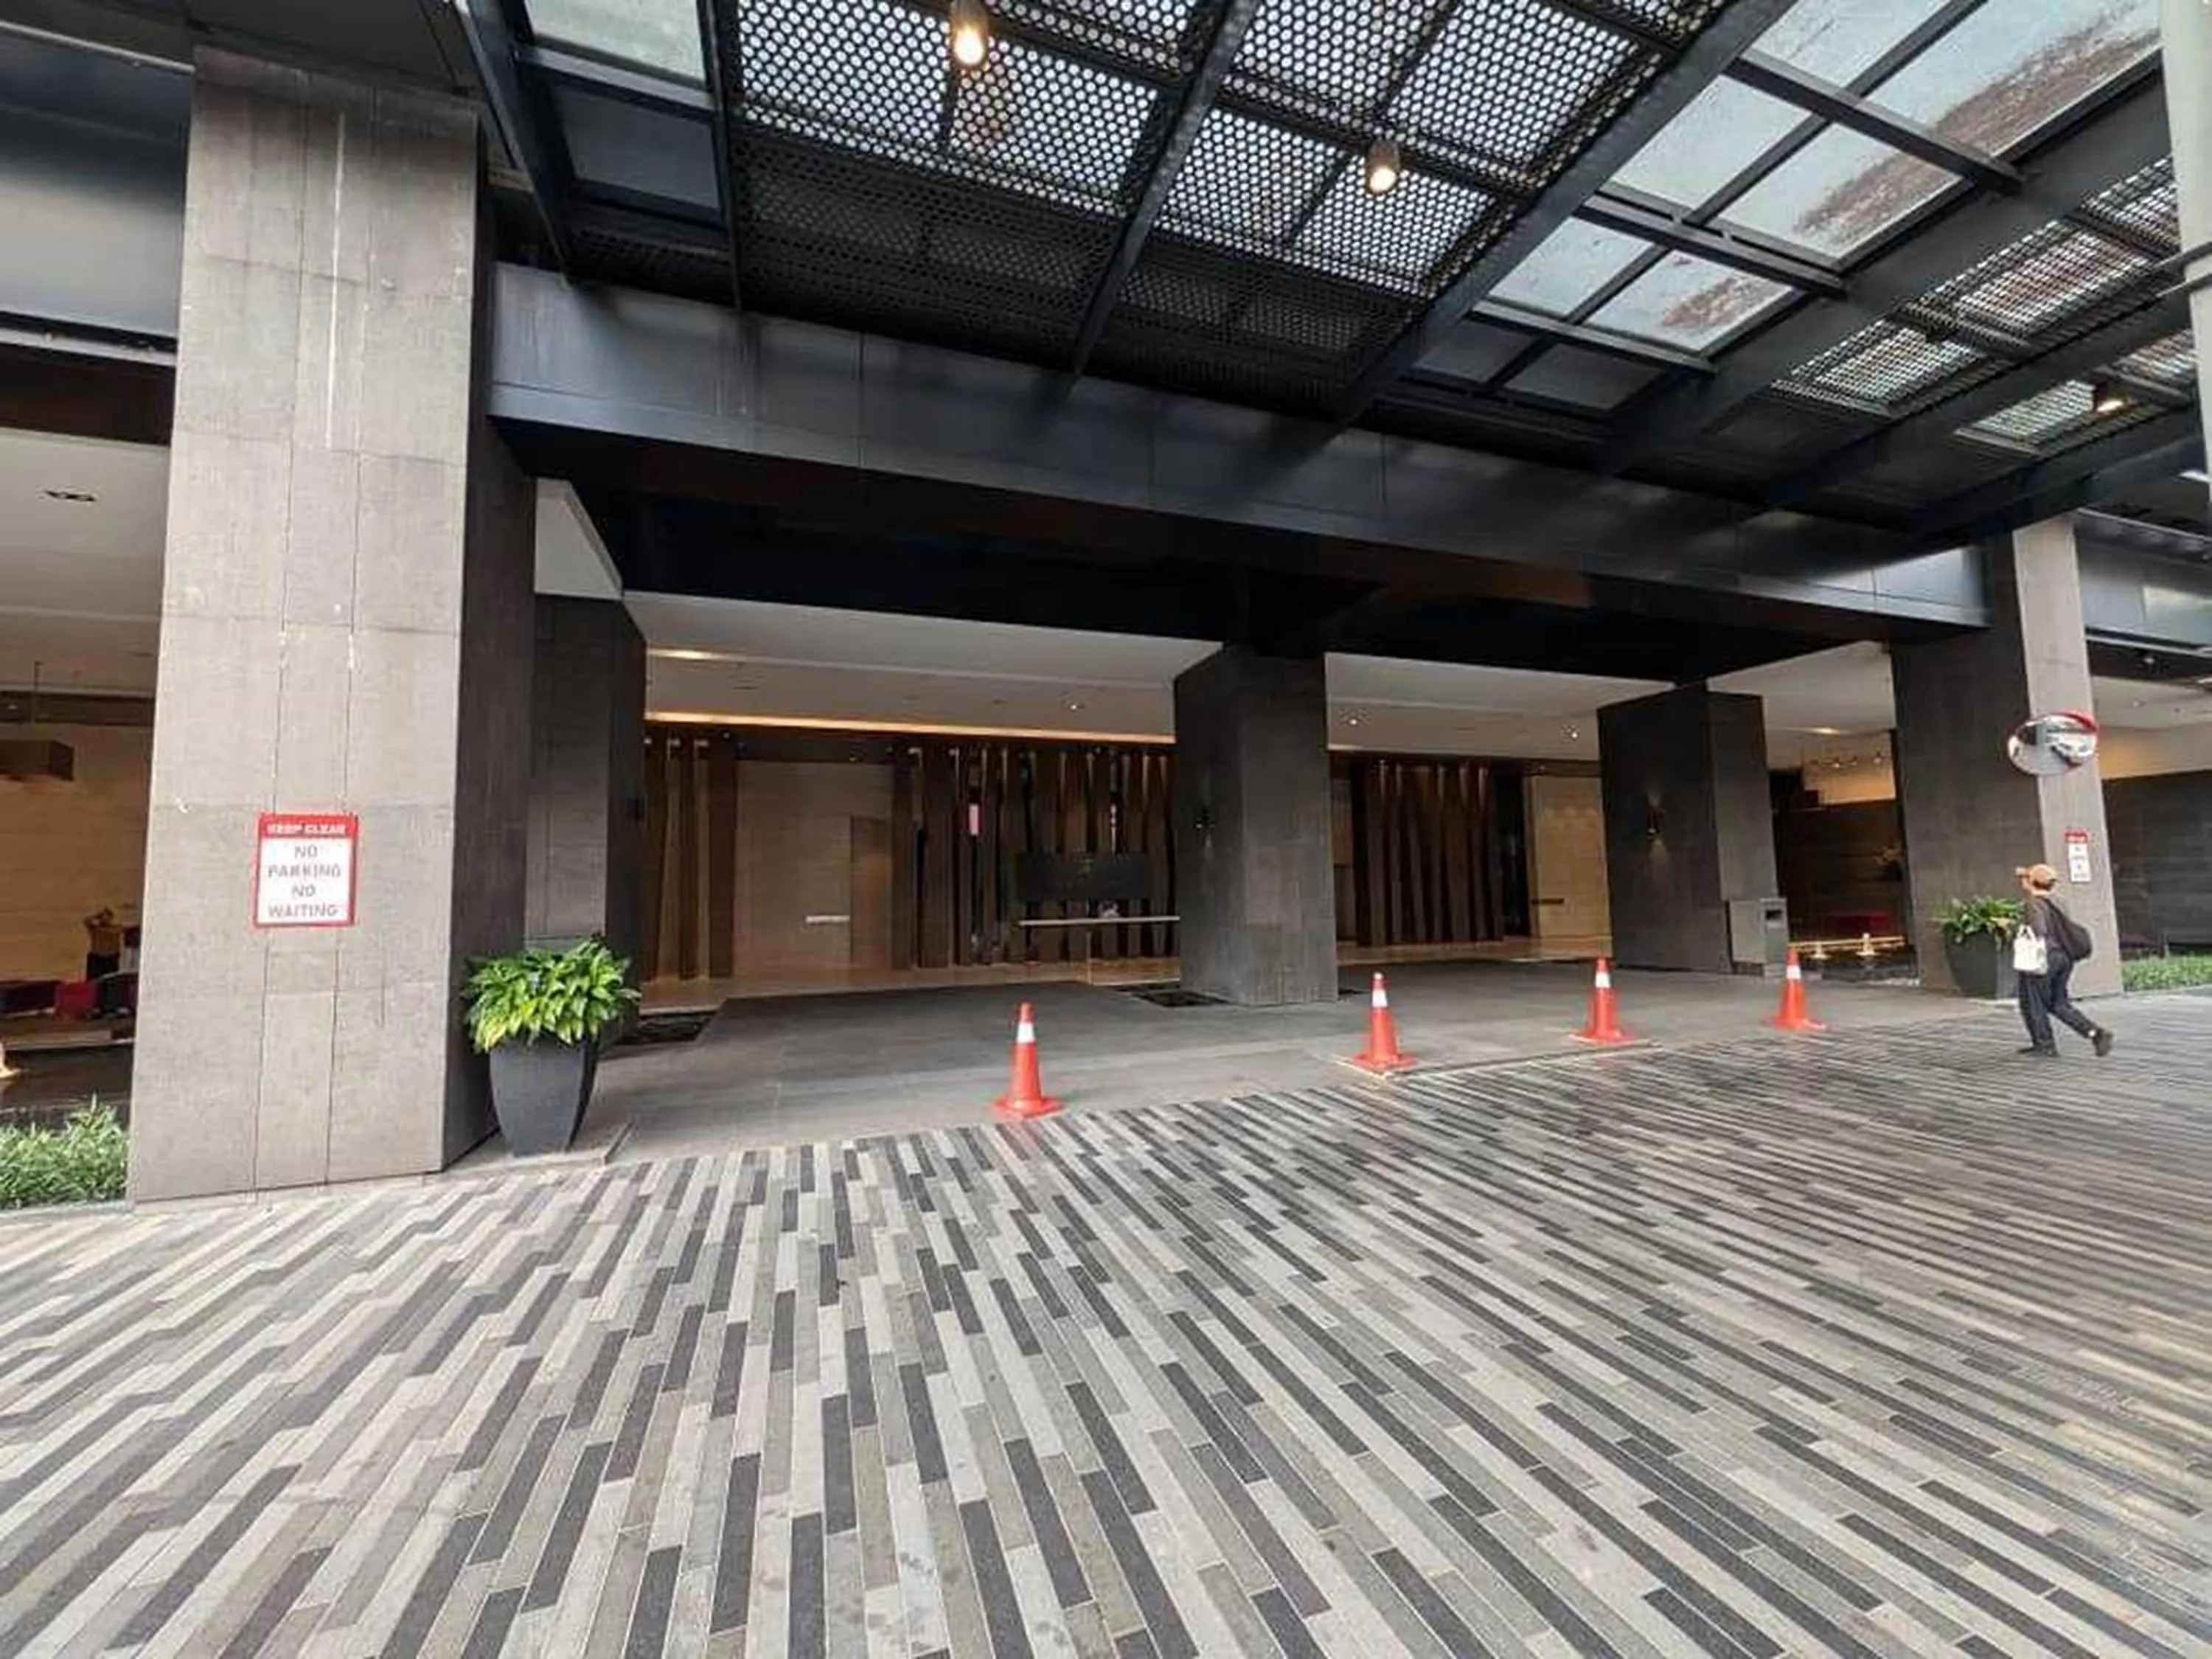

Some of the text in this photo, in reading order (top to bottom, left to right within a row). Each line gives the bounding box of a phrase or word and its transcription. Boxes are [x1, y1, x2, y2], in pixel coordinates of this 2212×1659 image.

[294, 845, 318, 858] NO
[268, 863, 341, 878] PARKING
[291, 884, 316, 897] NO
[268, 903, 339, 918] WAITING
